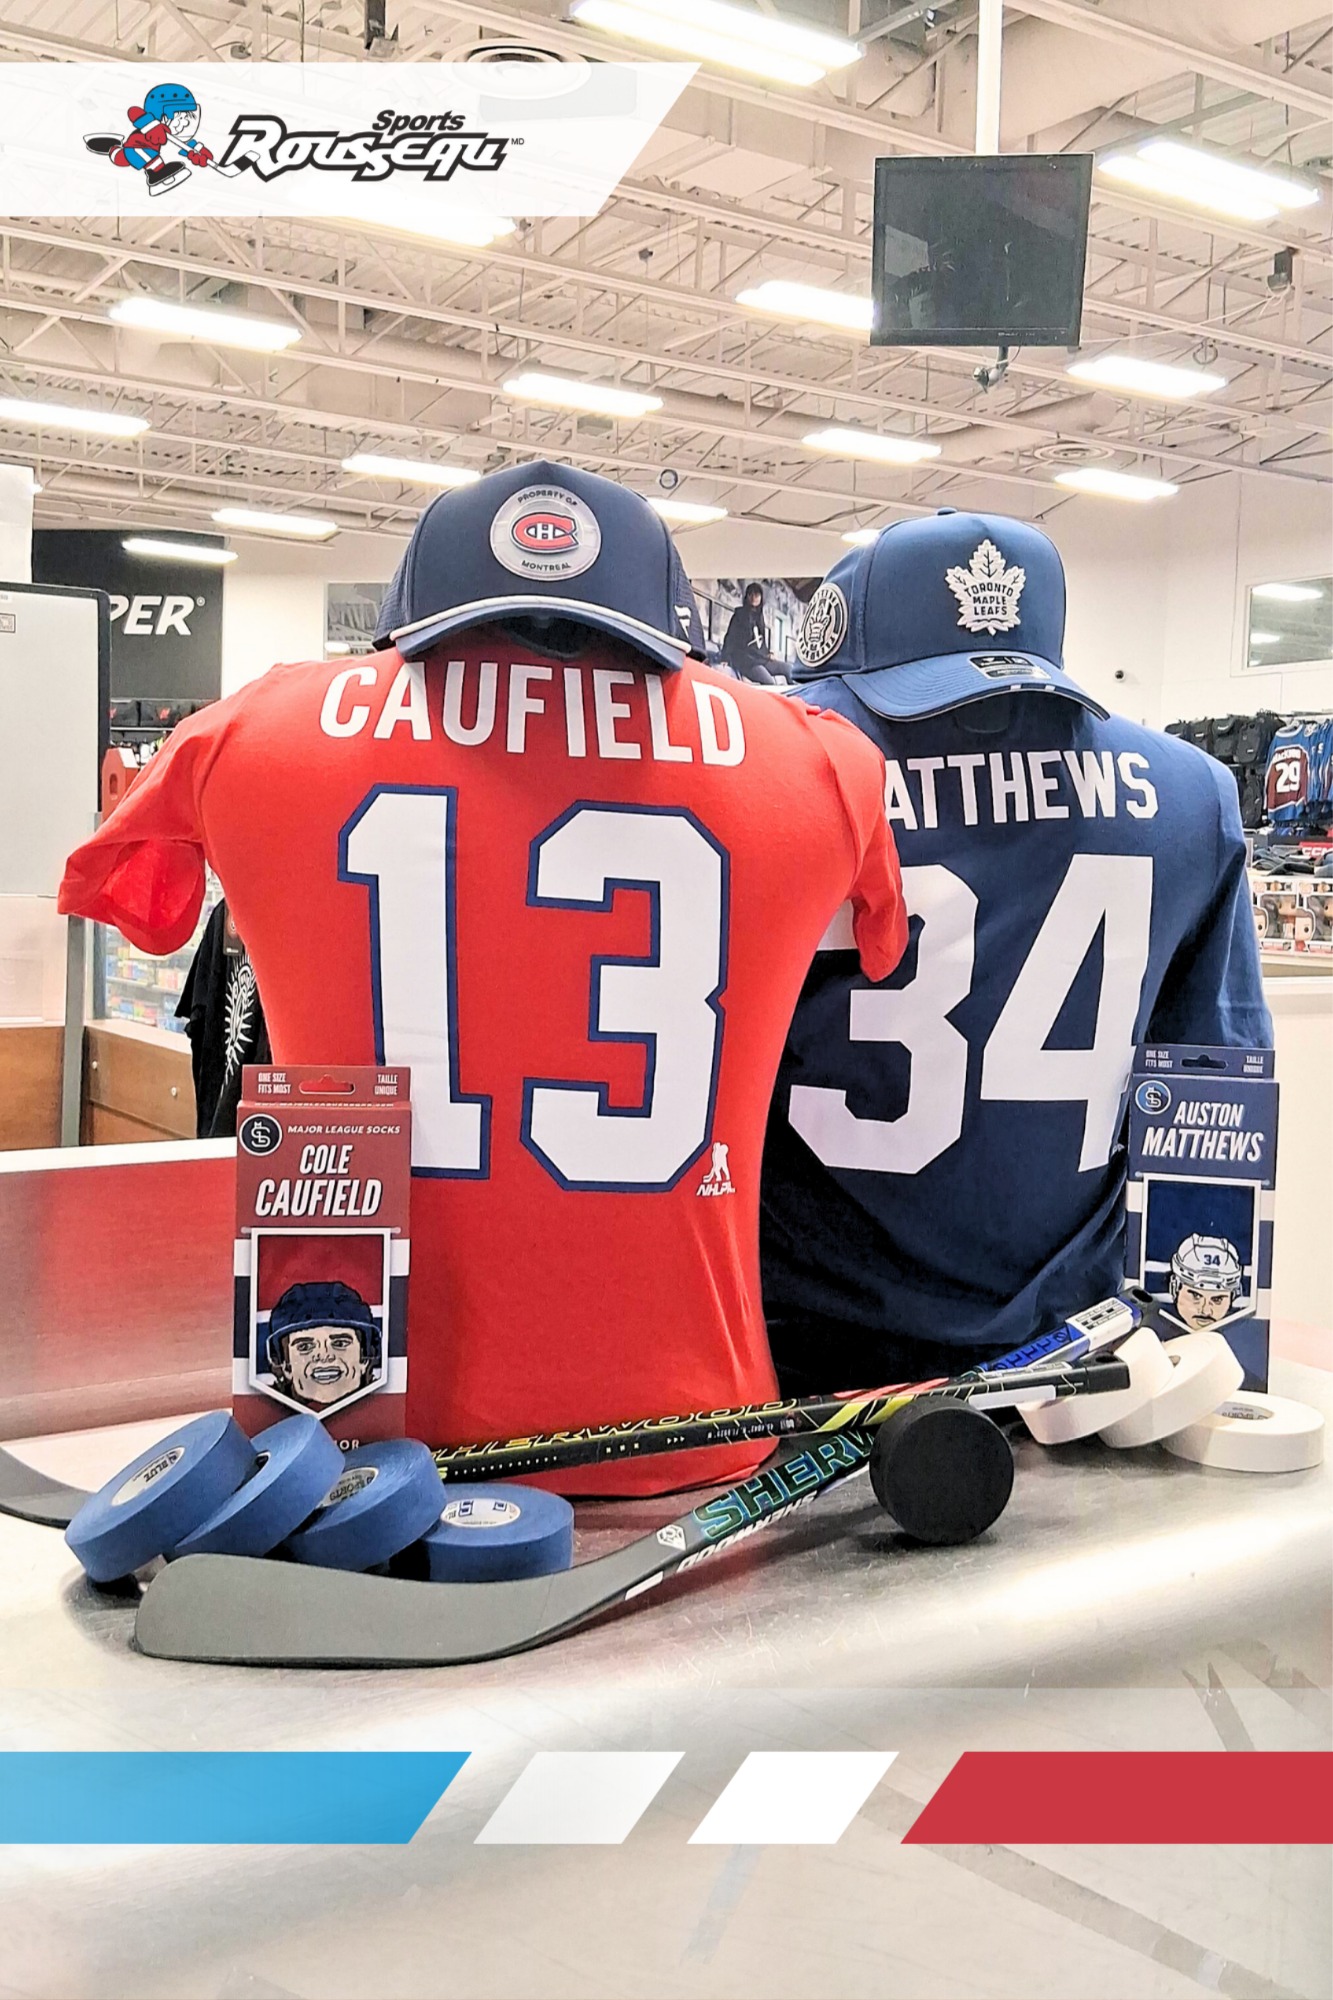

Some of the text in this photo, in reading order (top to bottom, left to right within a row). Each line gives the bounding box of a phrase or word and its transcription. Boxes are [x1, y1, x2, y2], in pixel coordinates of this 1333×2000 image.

[517, 489, 564, 503] PROPERTY
[521, 559, 571, 571] MONTREAL
[964, 582, 1014, 598] TORONTO
[973, 596, 1007, 605] MAPLE
[973, 605, 1008, 616] LEAFS
[319, 660, 746, 767] CAUFIELD
[1275, 760, 1301, 793] 29
[337, 782, 731, 1192] 13
[788, 853, 1153, 1175] 34
[258, 1072, 287, 1083] ONE SIZE
[377, 1074, 398, 1084] TAILLE
[257, 1084, 291, 1094] FITS MOST
[374, 1085, 398, 1096] UNIQUE
[1173, 1100, 1244, 1128] AUSTON
[287, 1125, 401, 1134] MAJOR LEAGUE SOCKS
[1141, 1126, 1265, 1163] MATTHEWS
[299, 1144, 354, 1175] COLE
[255, 1178, 383, 1217] CAUFIELD
[1203, 1254, 1221, 1267] 34
[429, 1398, 797, 1461] HERWOOD
[676, 1490, 819, 1574] SHERWOOD
